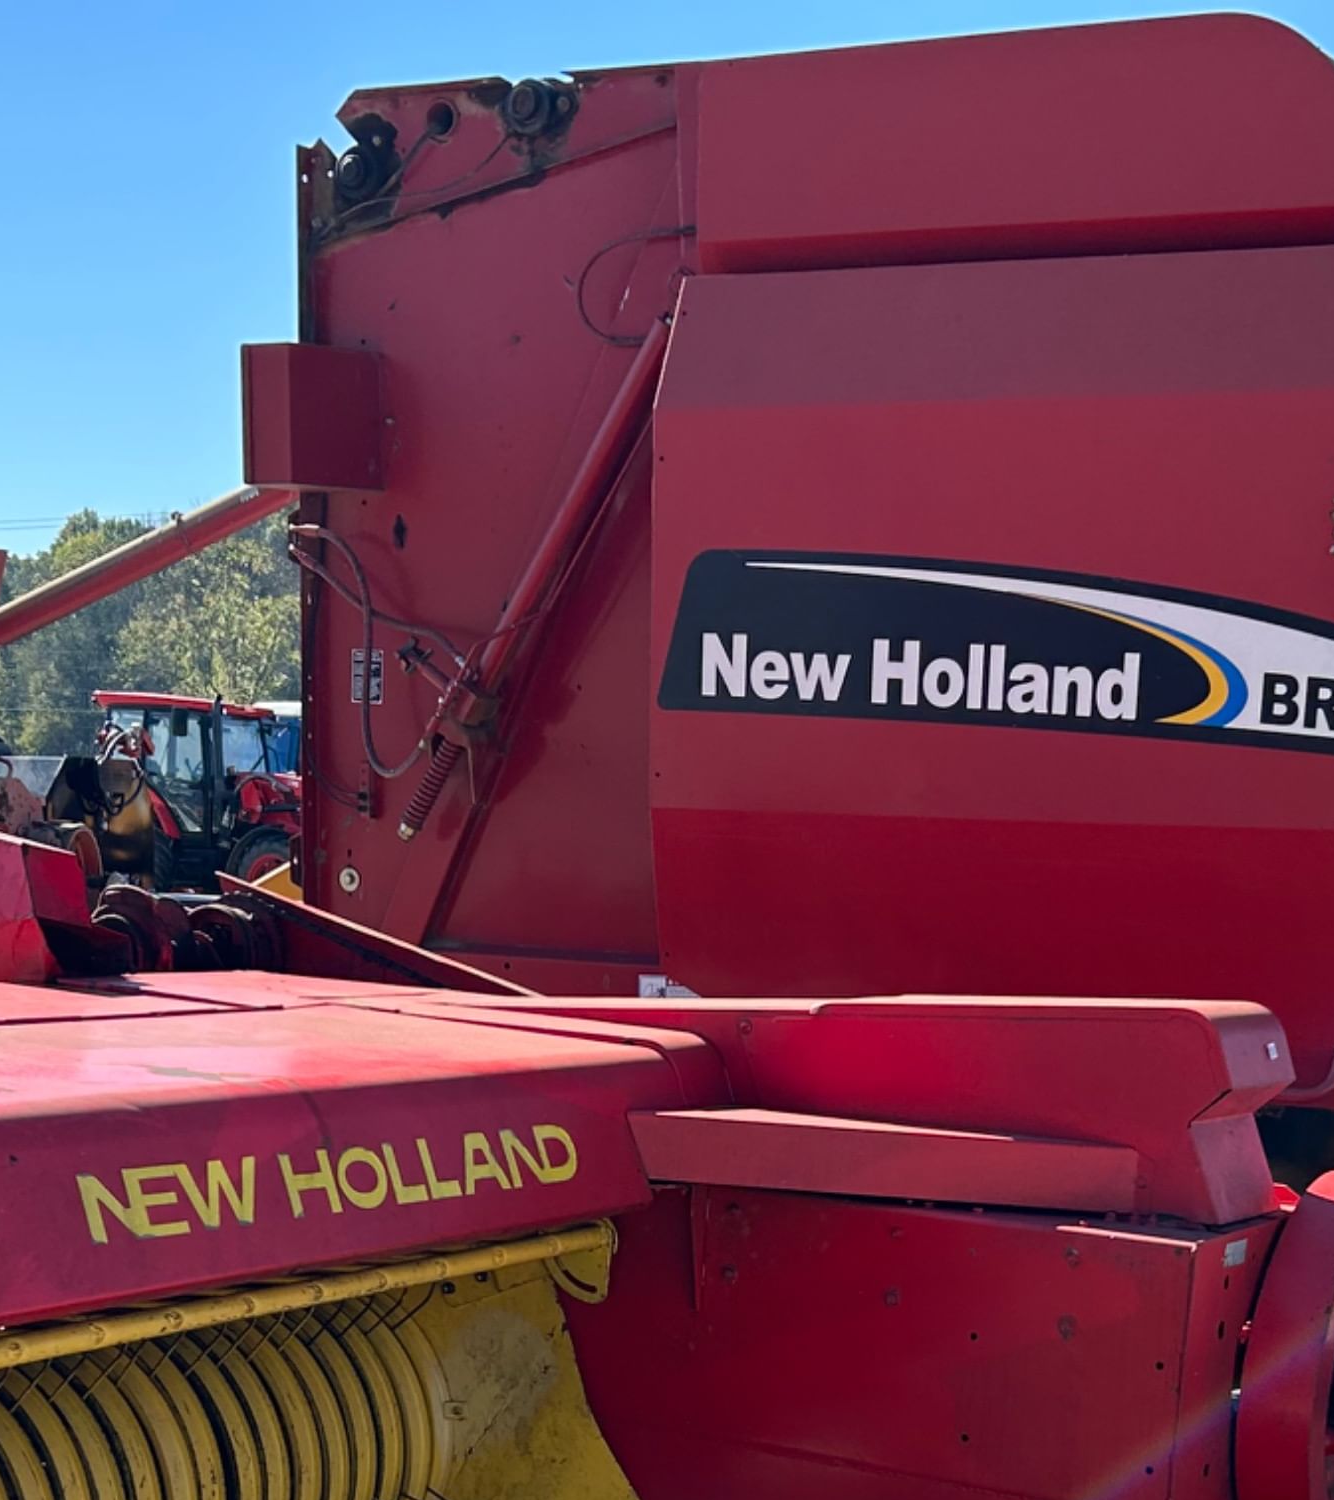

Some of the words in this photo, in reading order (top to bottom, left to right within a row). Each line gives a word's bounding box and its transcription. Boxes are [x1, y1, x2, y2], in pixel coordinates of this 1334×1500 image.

[701, 632, 851, 700] New
[871, 638, 1141, 720] Holland
[75, 1156, 255, 1245] NEW
[276, 1124, 578, 1218] HOLLAND
